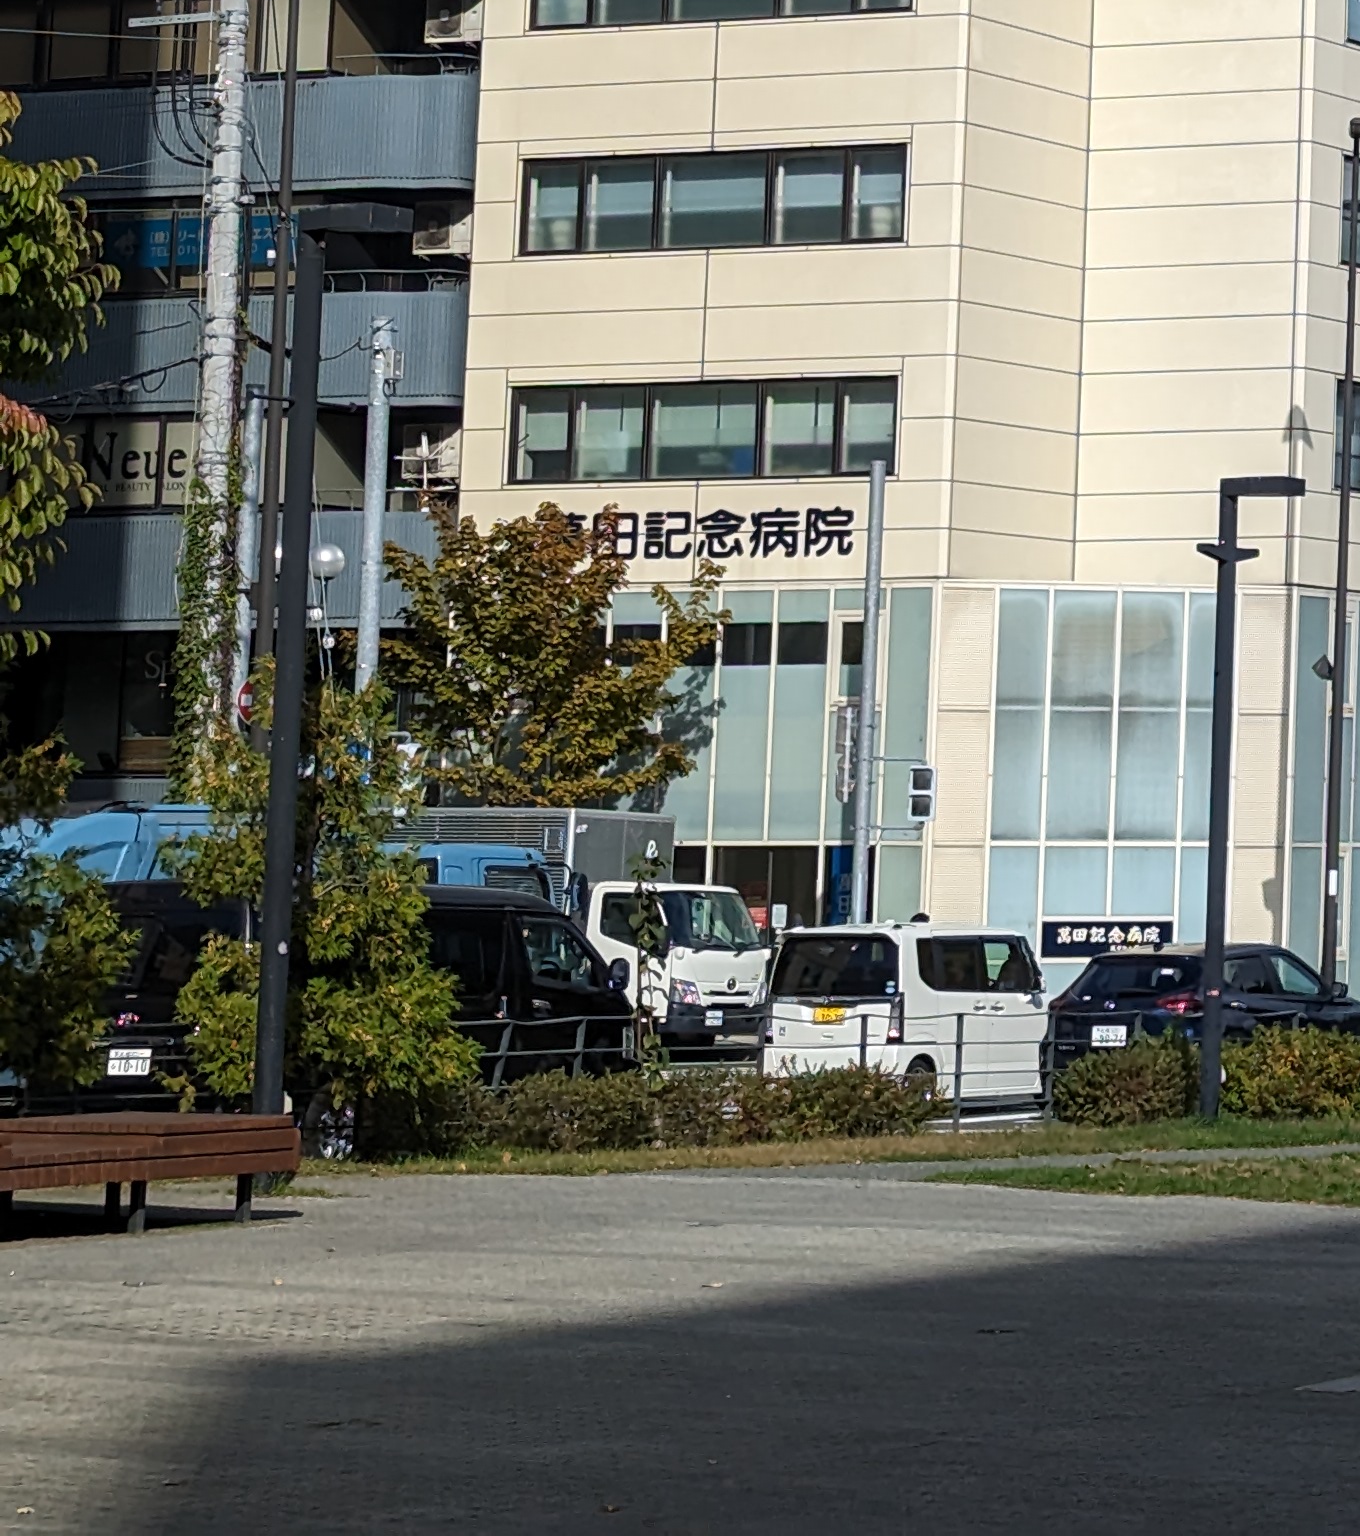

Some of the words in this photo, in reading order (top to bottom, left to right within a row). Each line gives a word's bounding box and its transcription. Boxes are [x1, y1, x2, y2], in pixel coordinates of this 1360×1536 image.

[565, 506, 854, 560] 田記念病院
